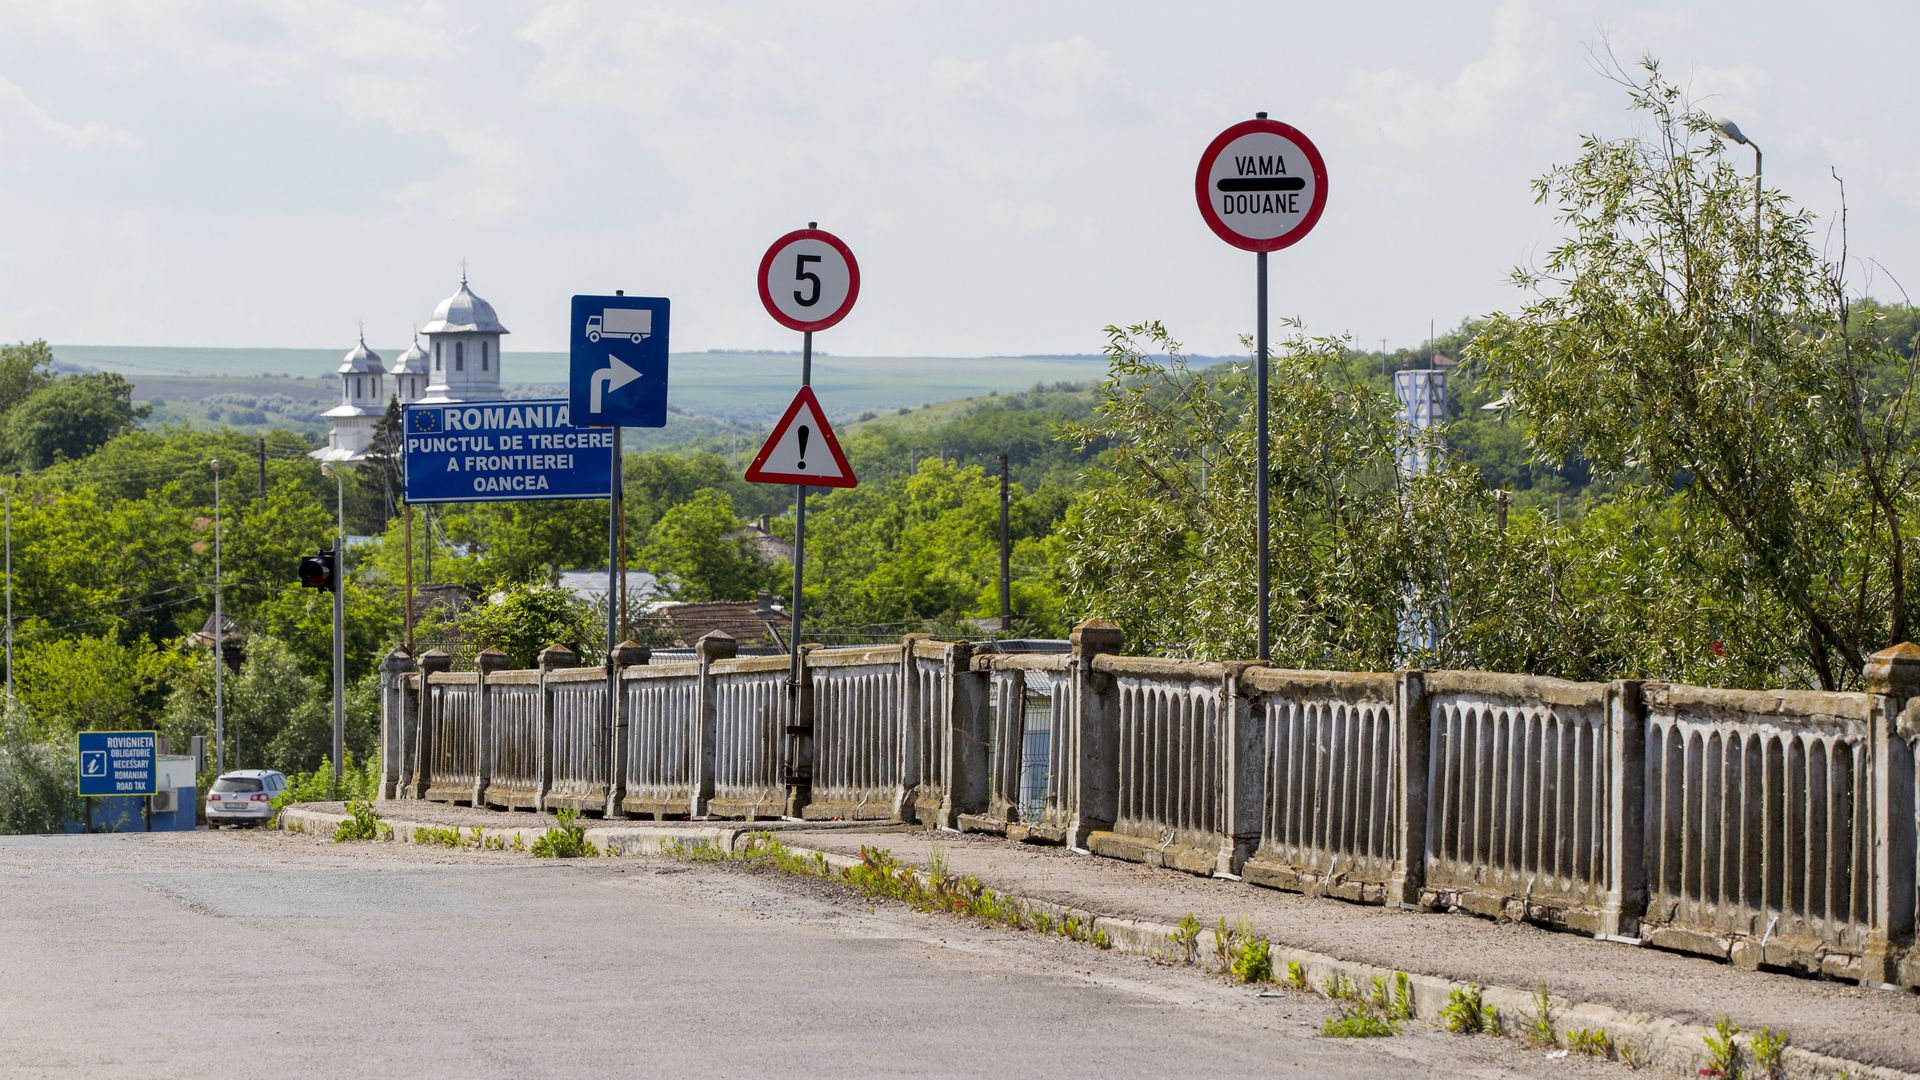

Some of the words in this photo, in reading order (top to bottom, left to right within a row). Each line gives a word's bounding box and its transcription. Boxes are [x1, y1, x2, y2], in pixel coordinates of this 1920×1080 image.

[1235, 155, 1286, 176] VAMA
[1224, 194, 1299, 214] DOUANE
[793, 254, 821, 307] 5
[444, 406, 573, 430] ROMANIA
[408, 436, 493, 453] PUNCTUL
[500, 435, 523, 450] DE
[528, 433, 612, 449] TRECERE
[447, 457, 460, 472] A
[465, 454, 573, 471] FRONTIEREI
[473, 475, 549, 492] OANCEA
[107, 737, 154, 748] ROVIGNIETA
[110, 748, 151, 758] OBLIGATORIE
[113, 759, 149, 769] NECESSARY
[114, 770, 148, 779] ROMANIAN
[116, 782, 133, 790] ROAD
[134, 781, 146, 790] TAX
